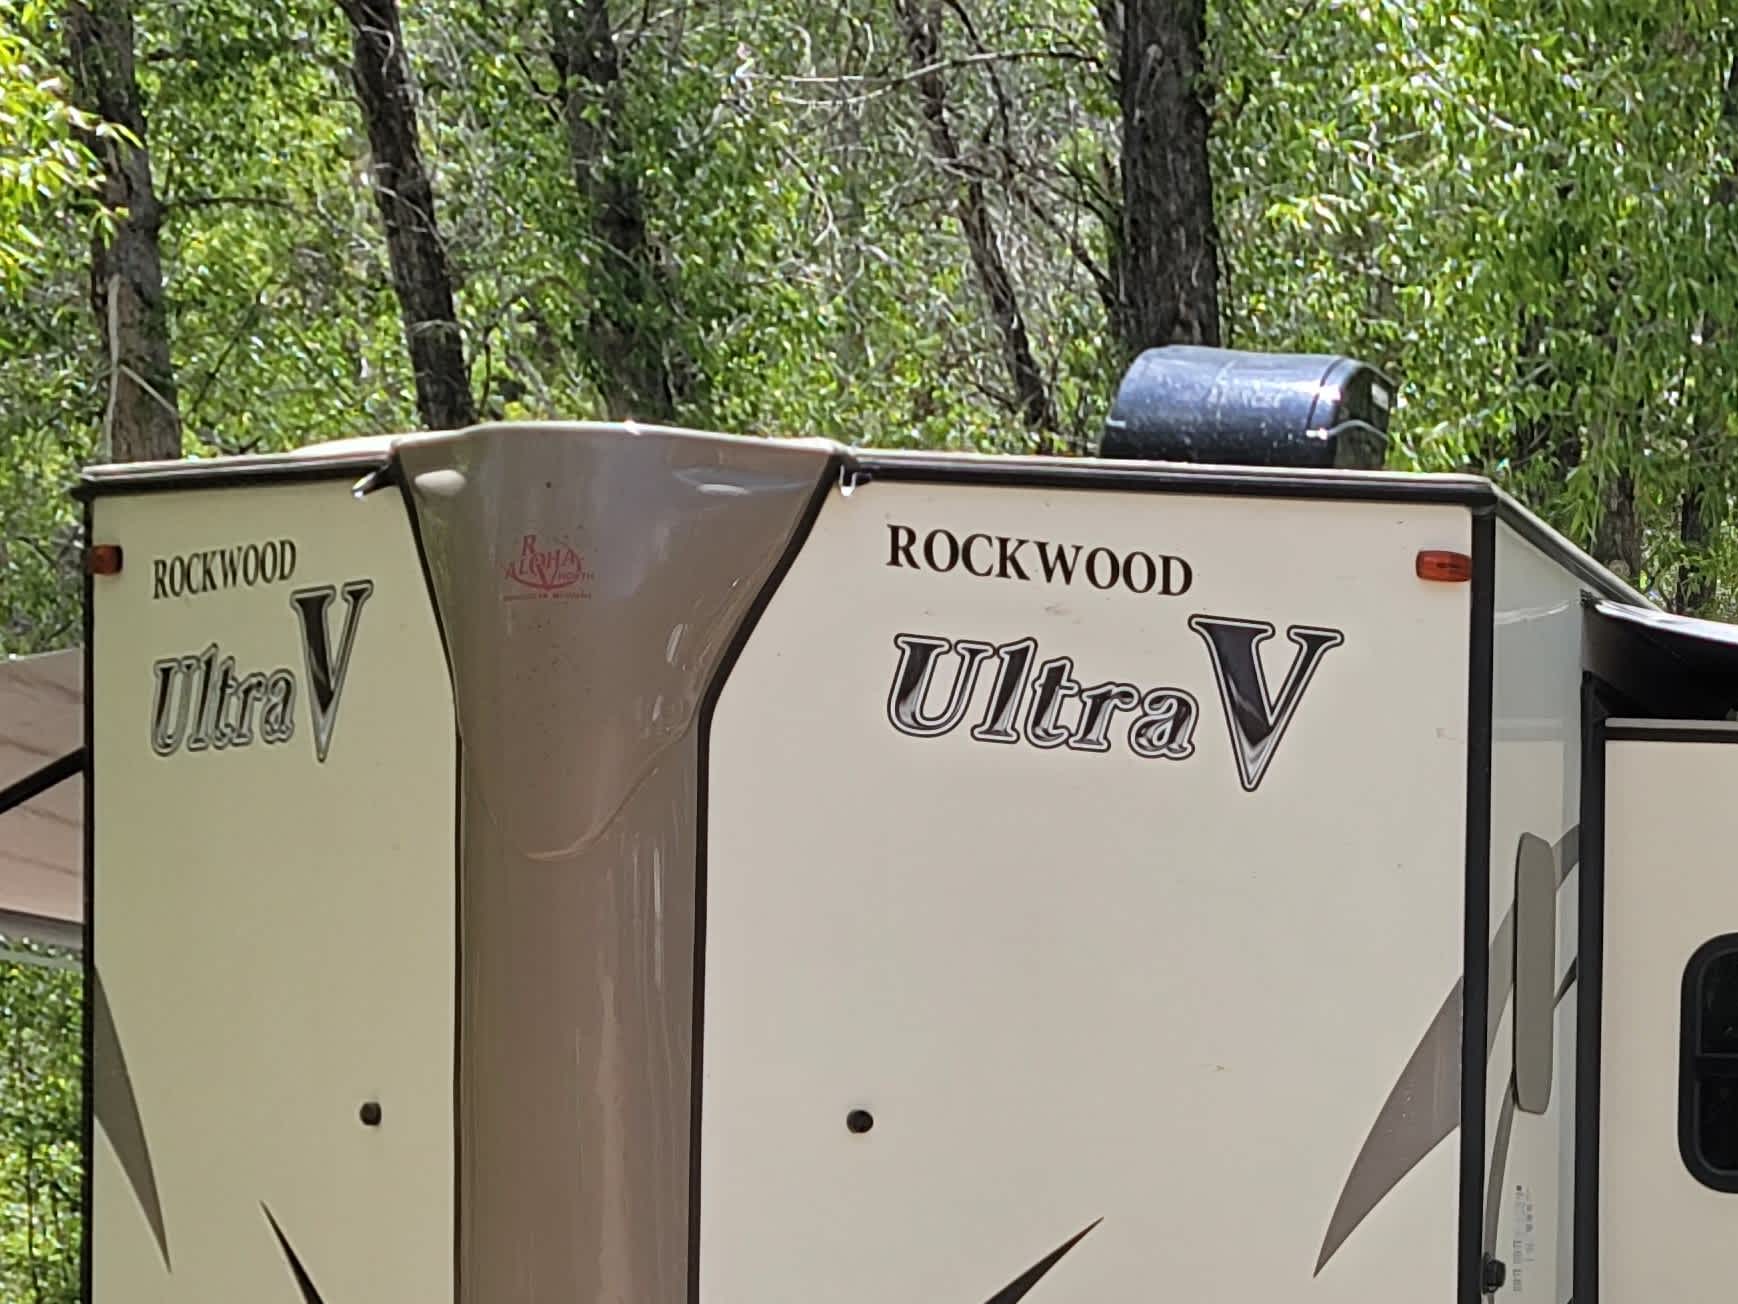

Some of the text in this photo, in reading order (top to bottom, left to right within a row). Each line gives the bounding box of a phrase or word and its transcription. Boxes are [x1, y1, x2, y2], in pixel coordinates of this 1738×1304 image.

[153, 539, 297, 600] ROCKWOOD
[887, 524, 1194, 598] ROCKWOOD
[151, 642, 297, 757] Ultra
[886, 632, 1200, 762] Ultra
